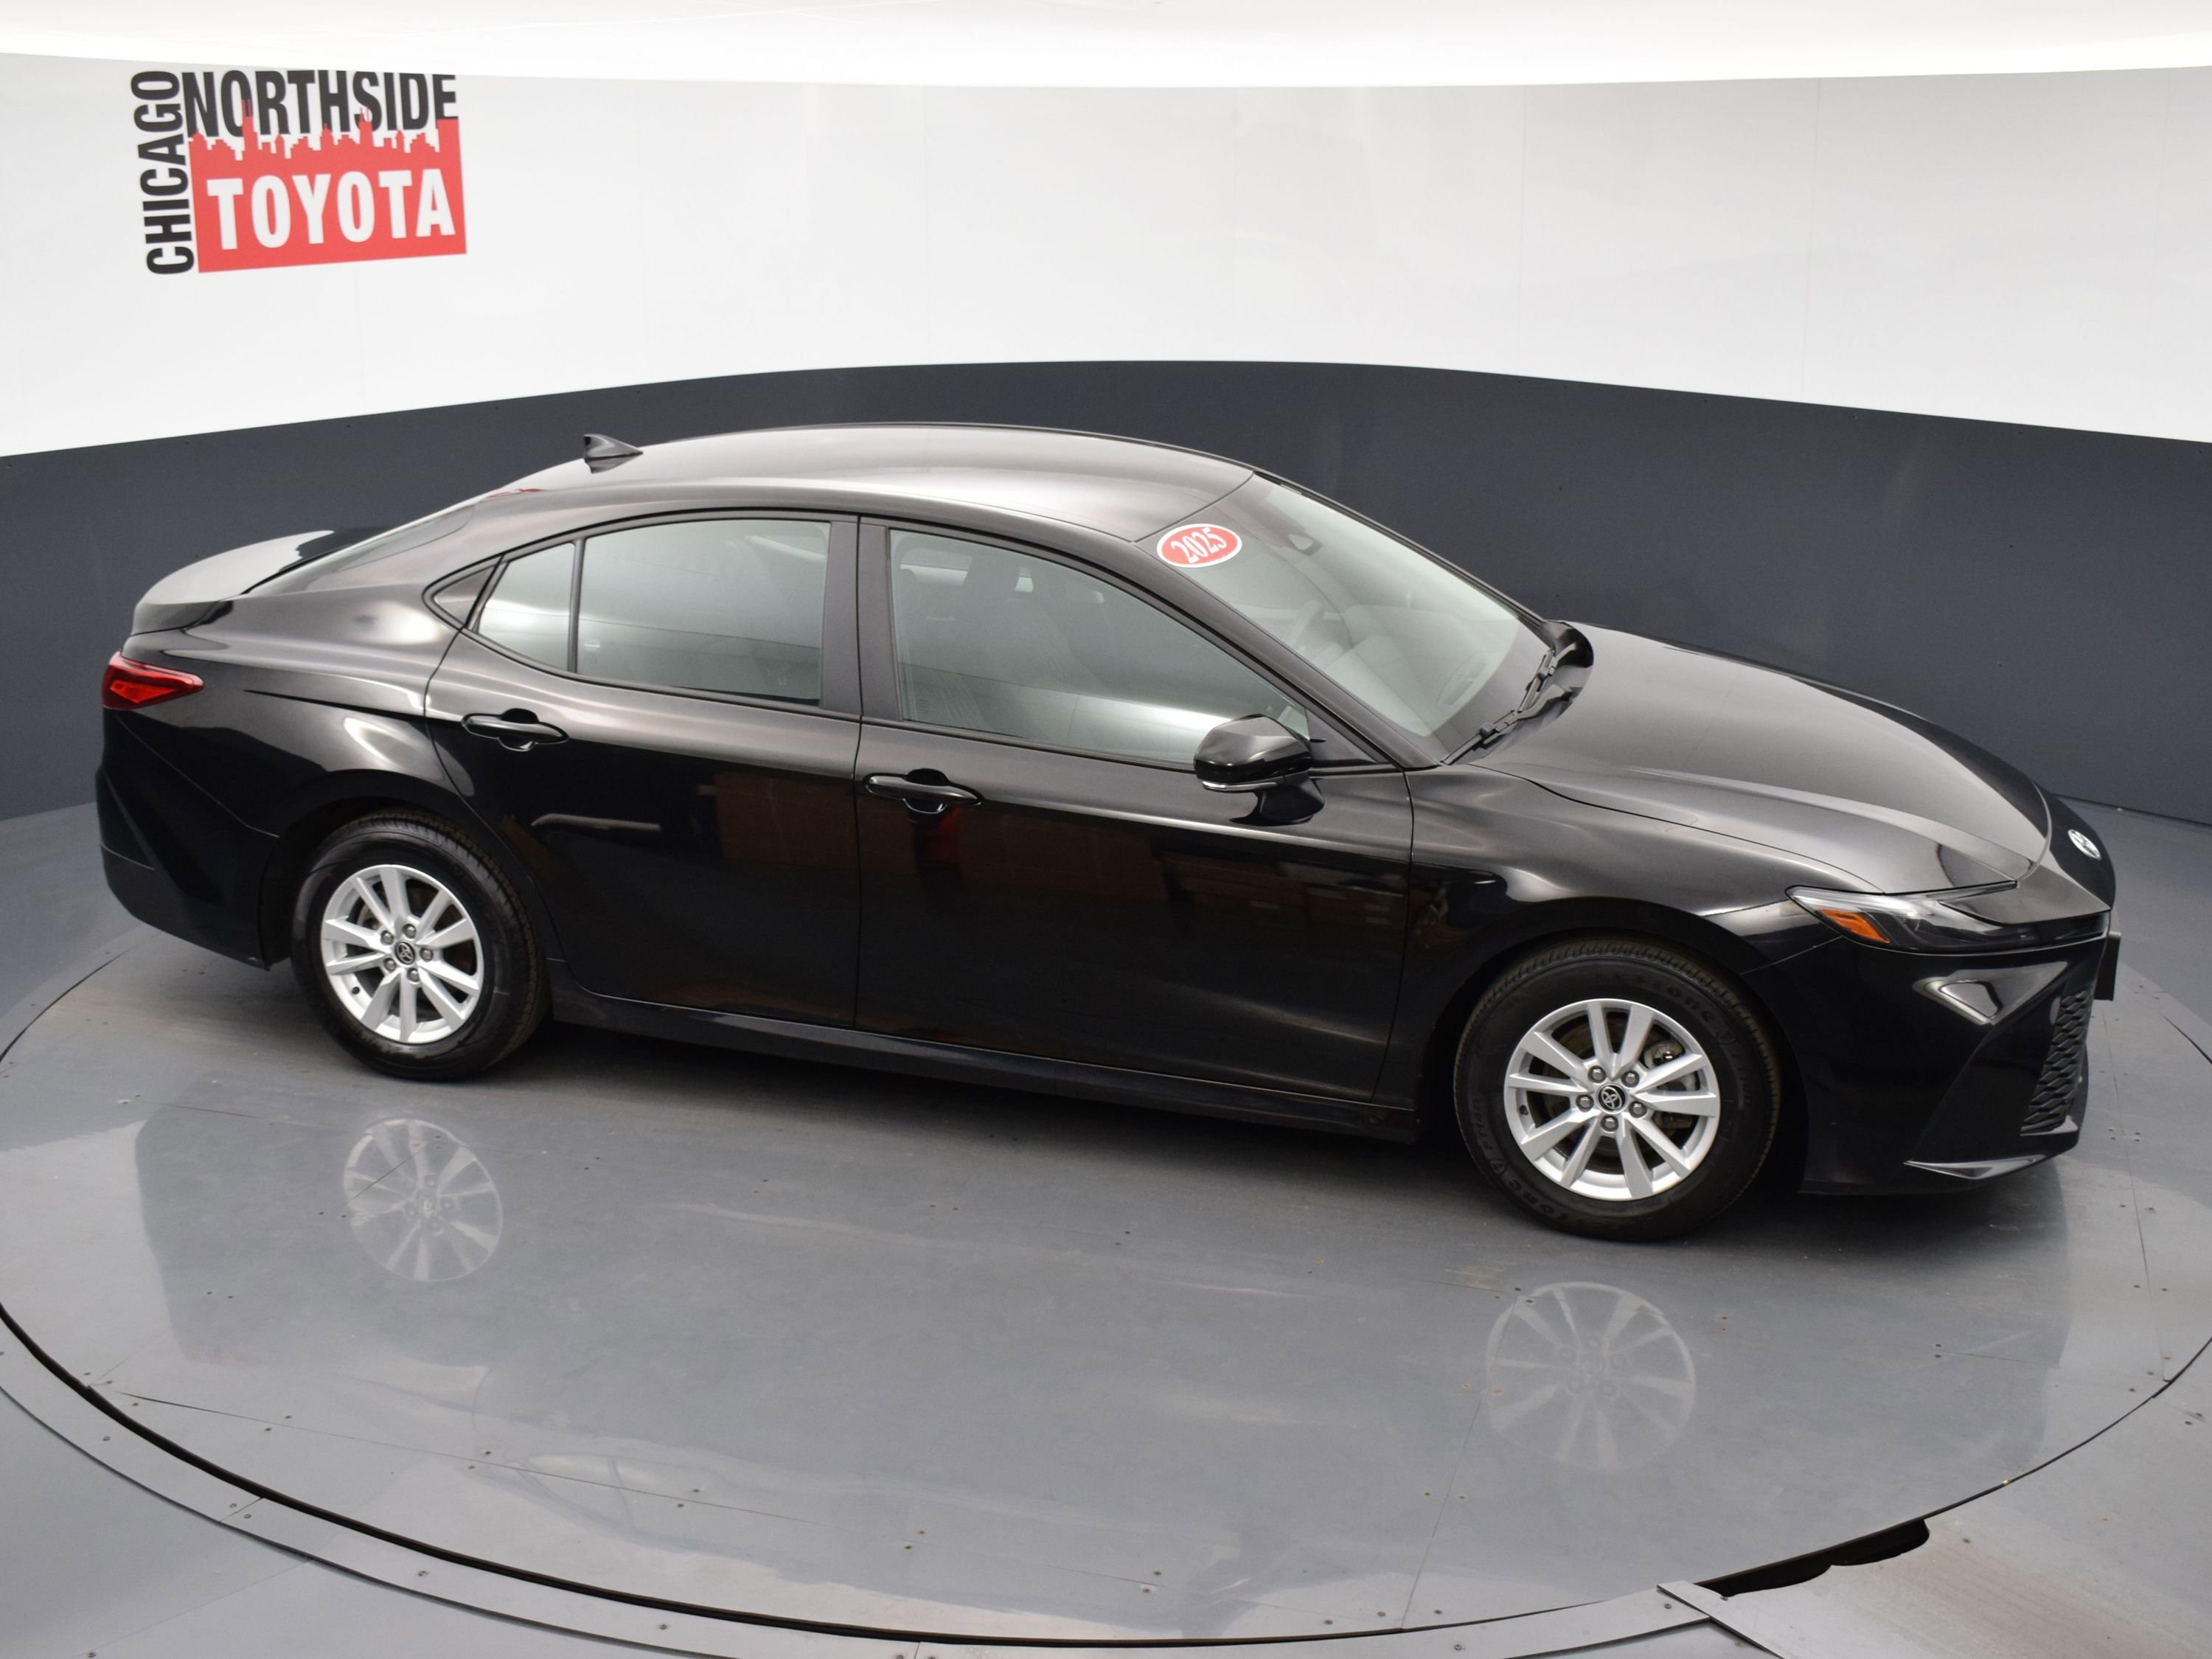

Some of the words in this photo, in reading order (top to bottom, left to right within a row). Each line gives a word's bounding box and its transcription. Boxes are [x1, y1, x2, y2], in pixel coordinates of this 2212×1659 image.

[181, 69, 459, 138] NORTHSIDE
[130, 70, 195, 275] CHICAGO
[206, 168, 456, 250] TOYOTA
[1171, 526, 1227, 563] 2025
